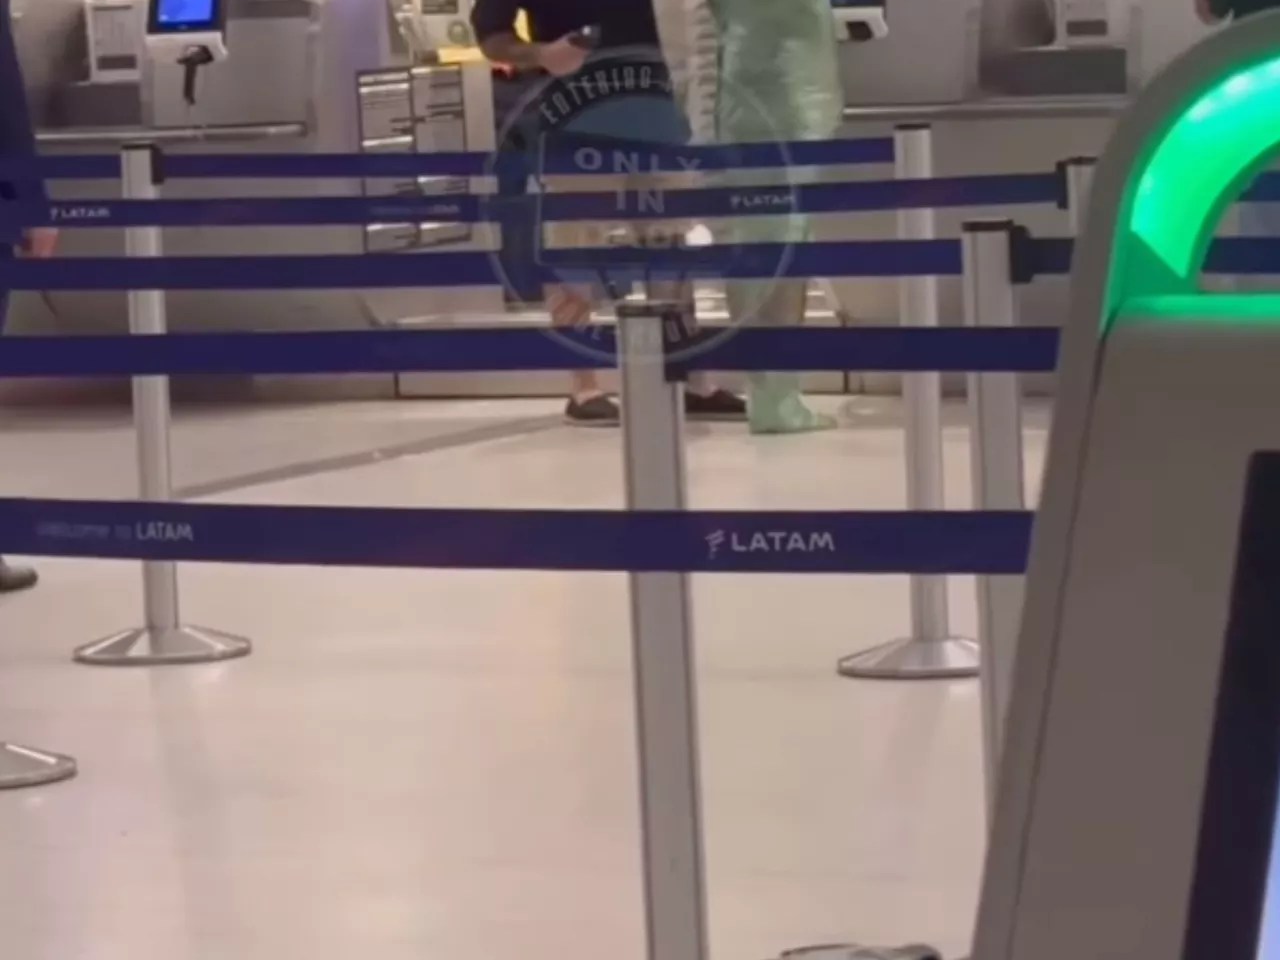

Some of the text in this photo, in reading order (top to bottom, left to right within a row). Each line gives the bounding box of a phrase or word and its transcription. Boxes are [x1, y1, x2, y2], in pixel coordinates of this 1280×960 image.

[61, 207, 110, 219] LATAM
[136, 522, 194, 542] LATAM
[731, 531, 836, 553] LATAM
